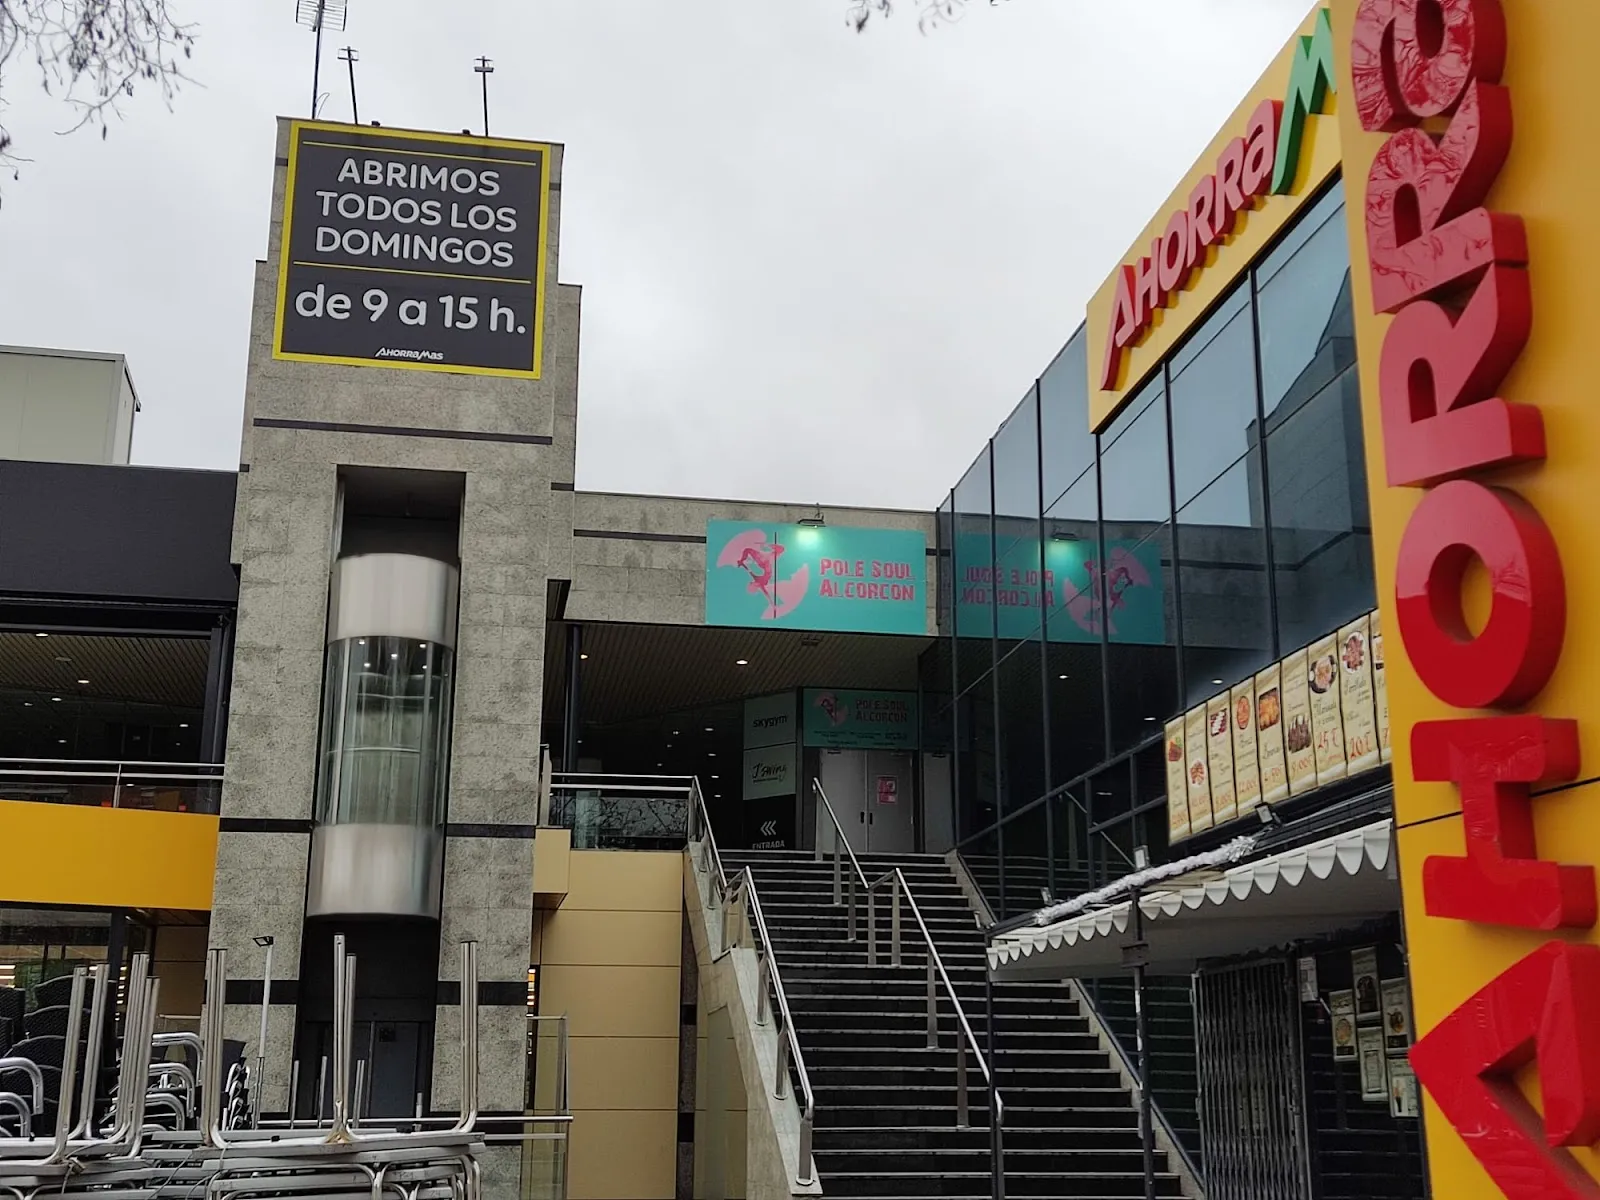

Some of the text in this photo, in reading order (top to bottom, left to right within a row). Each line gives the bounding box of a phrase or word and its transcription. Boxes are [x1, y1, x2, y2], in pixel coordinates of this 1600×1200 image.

[337, 158, 500, 196] ABRIMOS
[315, 190, 518, 232] TODOS LOS
[315, 226, 514, 268] DOMINGOS
[295, 284, 526, 334] de 9 a 15 h.
[819, 558, 916, 581] POLE SOUL
[819, 579, 915, 601] ALCORCON
[855, 699, 909, 711] POLE SOUL
[752, 714, 788, 728] skygym
[751, 839, 786, 850] ENTRADA
